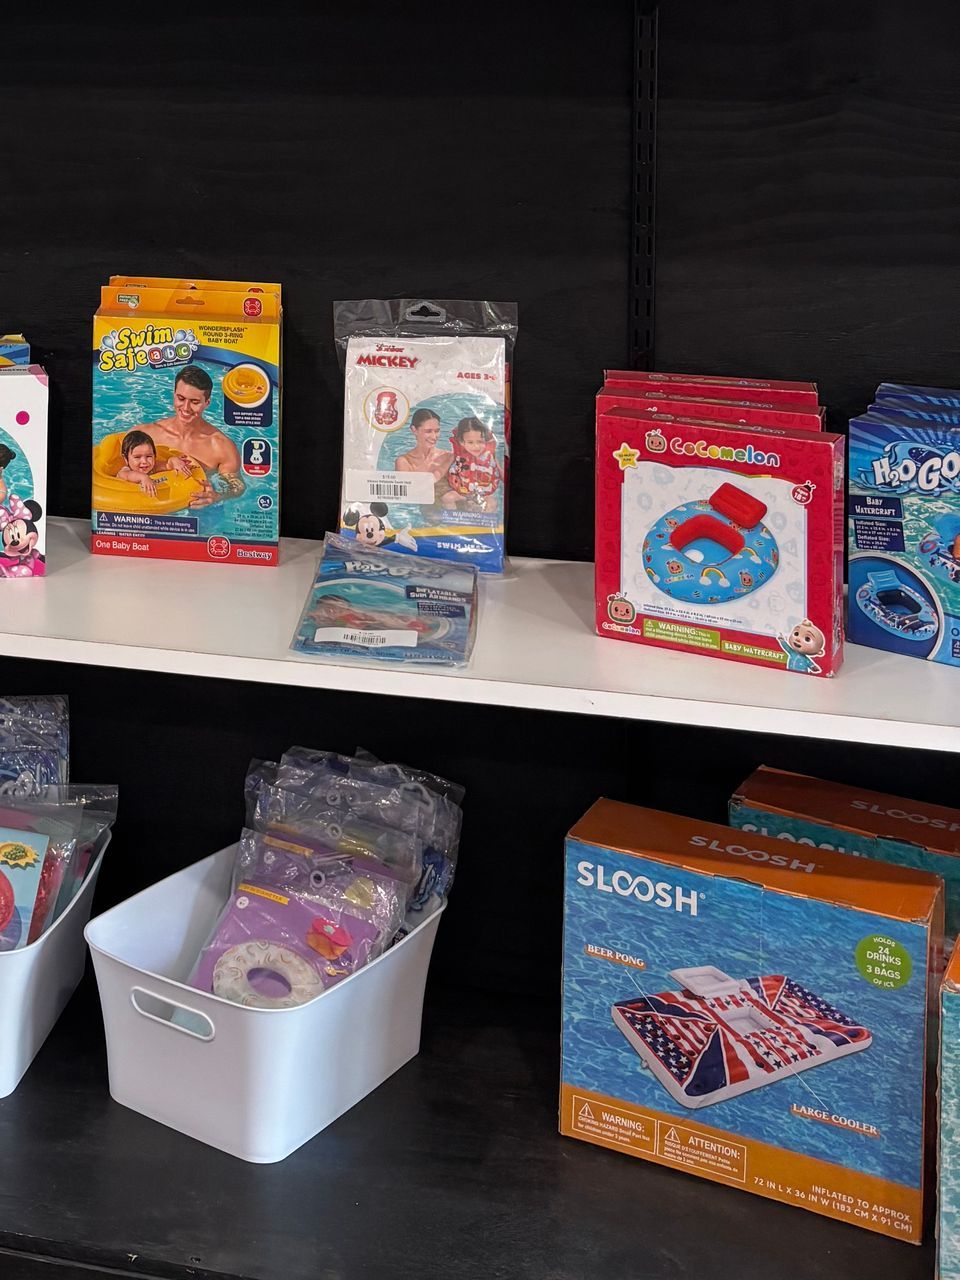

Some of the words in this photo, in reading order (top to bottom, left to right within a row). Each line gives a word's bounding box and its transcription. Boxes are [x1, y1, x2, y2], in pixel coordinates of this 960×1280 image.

[116, 325, 173, 350] Swim
[100, 350, 148, 370] Safe
[356, 354, 419, 368] MICKEY
[670, 438, 780, 467] CoComelon
[873, 452, 960, 490] H2OGO
[866, 496, 882, 506] BABY
[855, 506, 895, 515] WATERCRAFT
[114, 516, 152, 524] WARNING:
[96, 540, 110, 548] One
[112, 541, 130, 551] Baby
[132, 542, 149, 551] Boat
[237, 549, 272, 560] Bestway
[659, 623, 698, 636] WARNING:
[724, 643, 741, 652] BABY
[743, 647, 784, 660] WATERCRAFT
[873, 937, 895, 947] HOLDS
[587, 944, 613, 957] BEER
[615, 950, 645, 966] PONG
[878, 946, 890, 954] 24
[866, 951, 901, 965] DRINKS
[875, 967, 900, 979] BAGS
[602, 1111, 645, 1132] WARNING:
[793, 1103, 829, 1121] LARGE
[832, 1115, 878, 1135] COOLER
[689, 1136, 740, 1160] ATTENTION:
[754, 1176, 764, 1186] 72
[767, 1181, 776, 1189] IN
[794, 1190, 805, 1198] 36
[809, 1194, 817, 1203] IN
[820, 1198, 830, 1207] W
[832, 1202, 851, 1214] (183
[855, 1208, 869, 1219] CM
[880, 1216, 891, 1225] 91
[894, 1220, 912, 1234] CM)
[812, 1185, 854, 1204] INFLATED
[857, 1199, 869, 1208] TO
[872, 1205, 912, 1222] APPROX.
